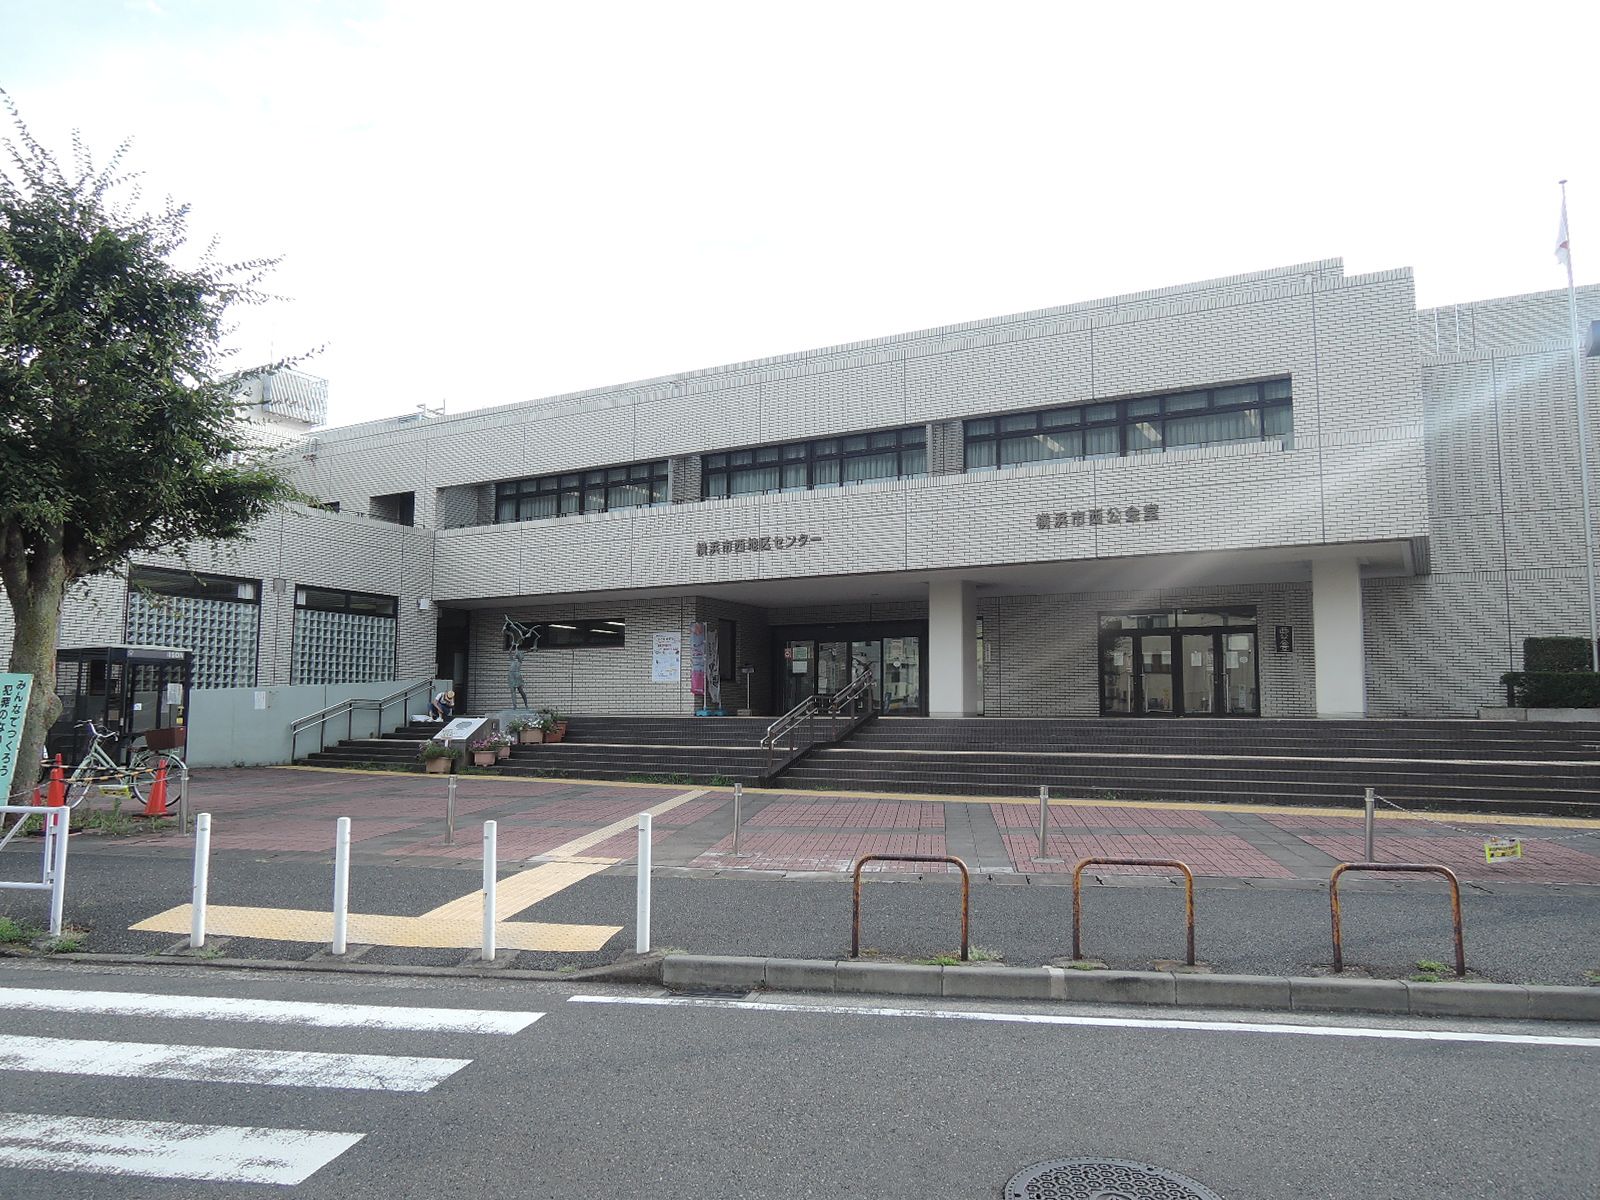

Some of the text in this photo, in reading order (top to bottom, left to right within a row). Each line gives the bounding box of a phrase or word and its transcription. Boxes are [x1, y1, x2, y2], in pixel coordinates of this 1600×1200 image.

[1037, 504, 1159, 530] 横浜市西公会堂
[697, 534, 821, 557] 横浜市西地区センター
[0, 680, 26, 776] みんなでつくろう
